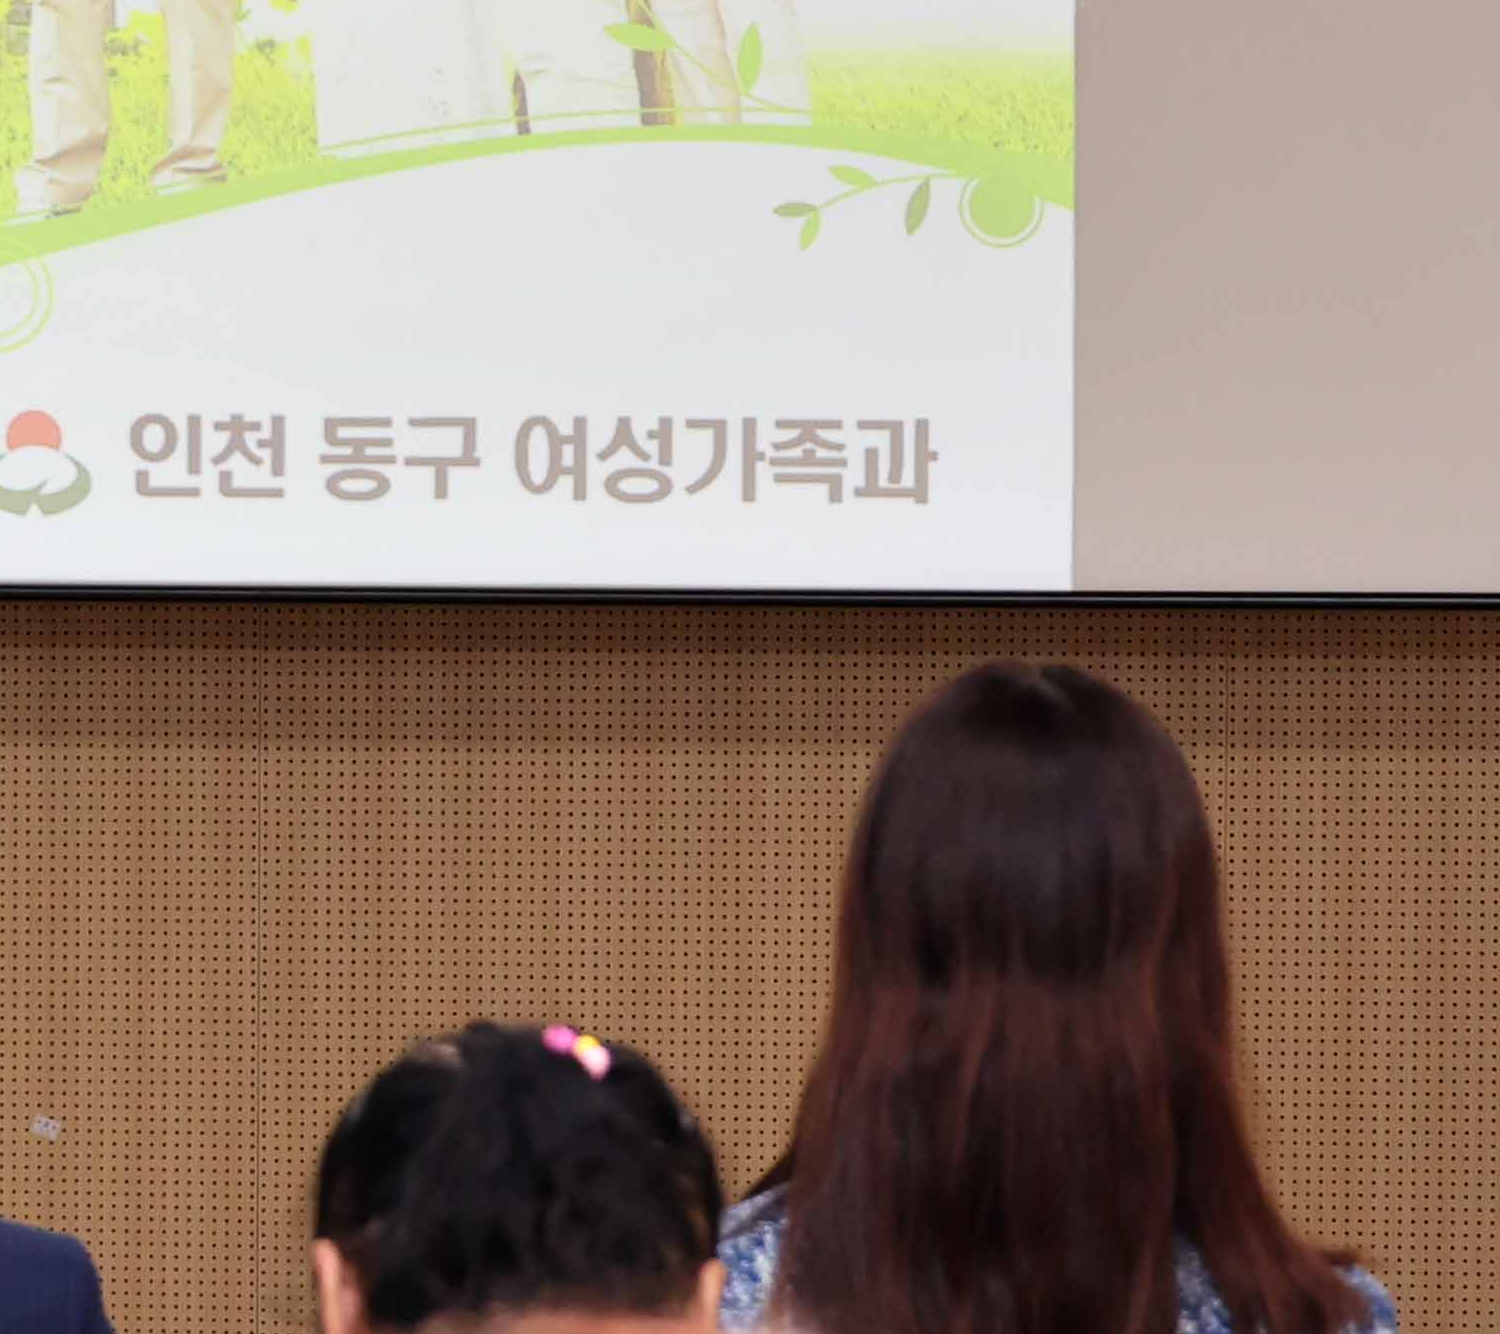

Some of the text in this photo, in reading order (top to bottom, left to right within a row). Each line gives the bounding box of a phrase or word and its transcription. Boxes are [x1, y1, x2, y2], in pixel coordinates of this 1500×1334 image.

[128, 412, 940, 506] 인천 동구 여성가족과
